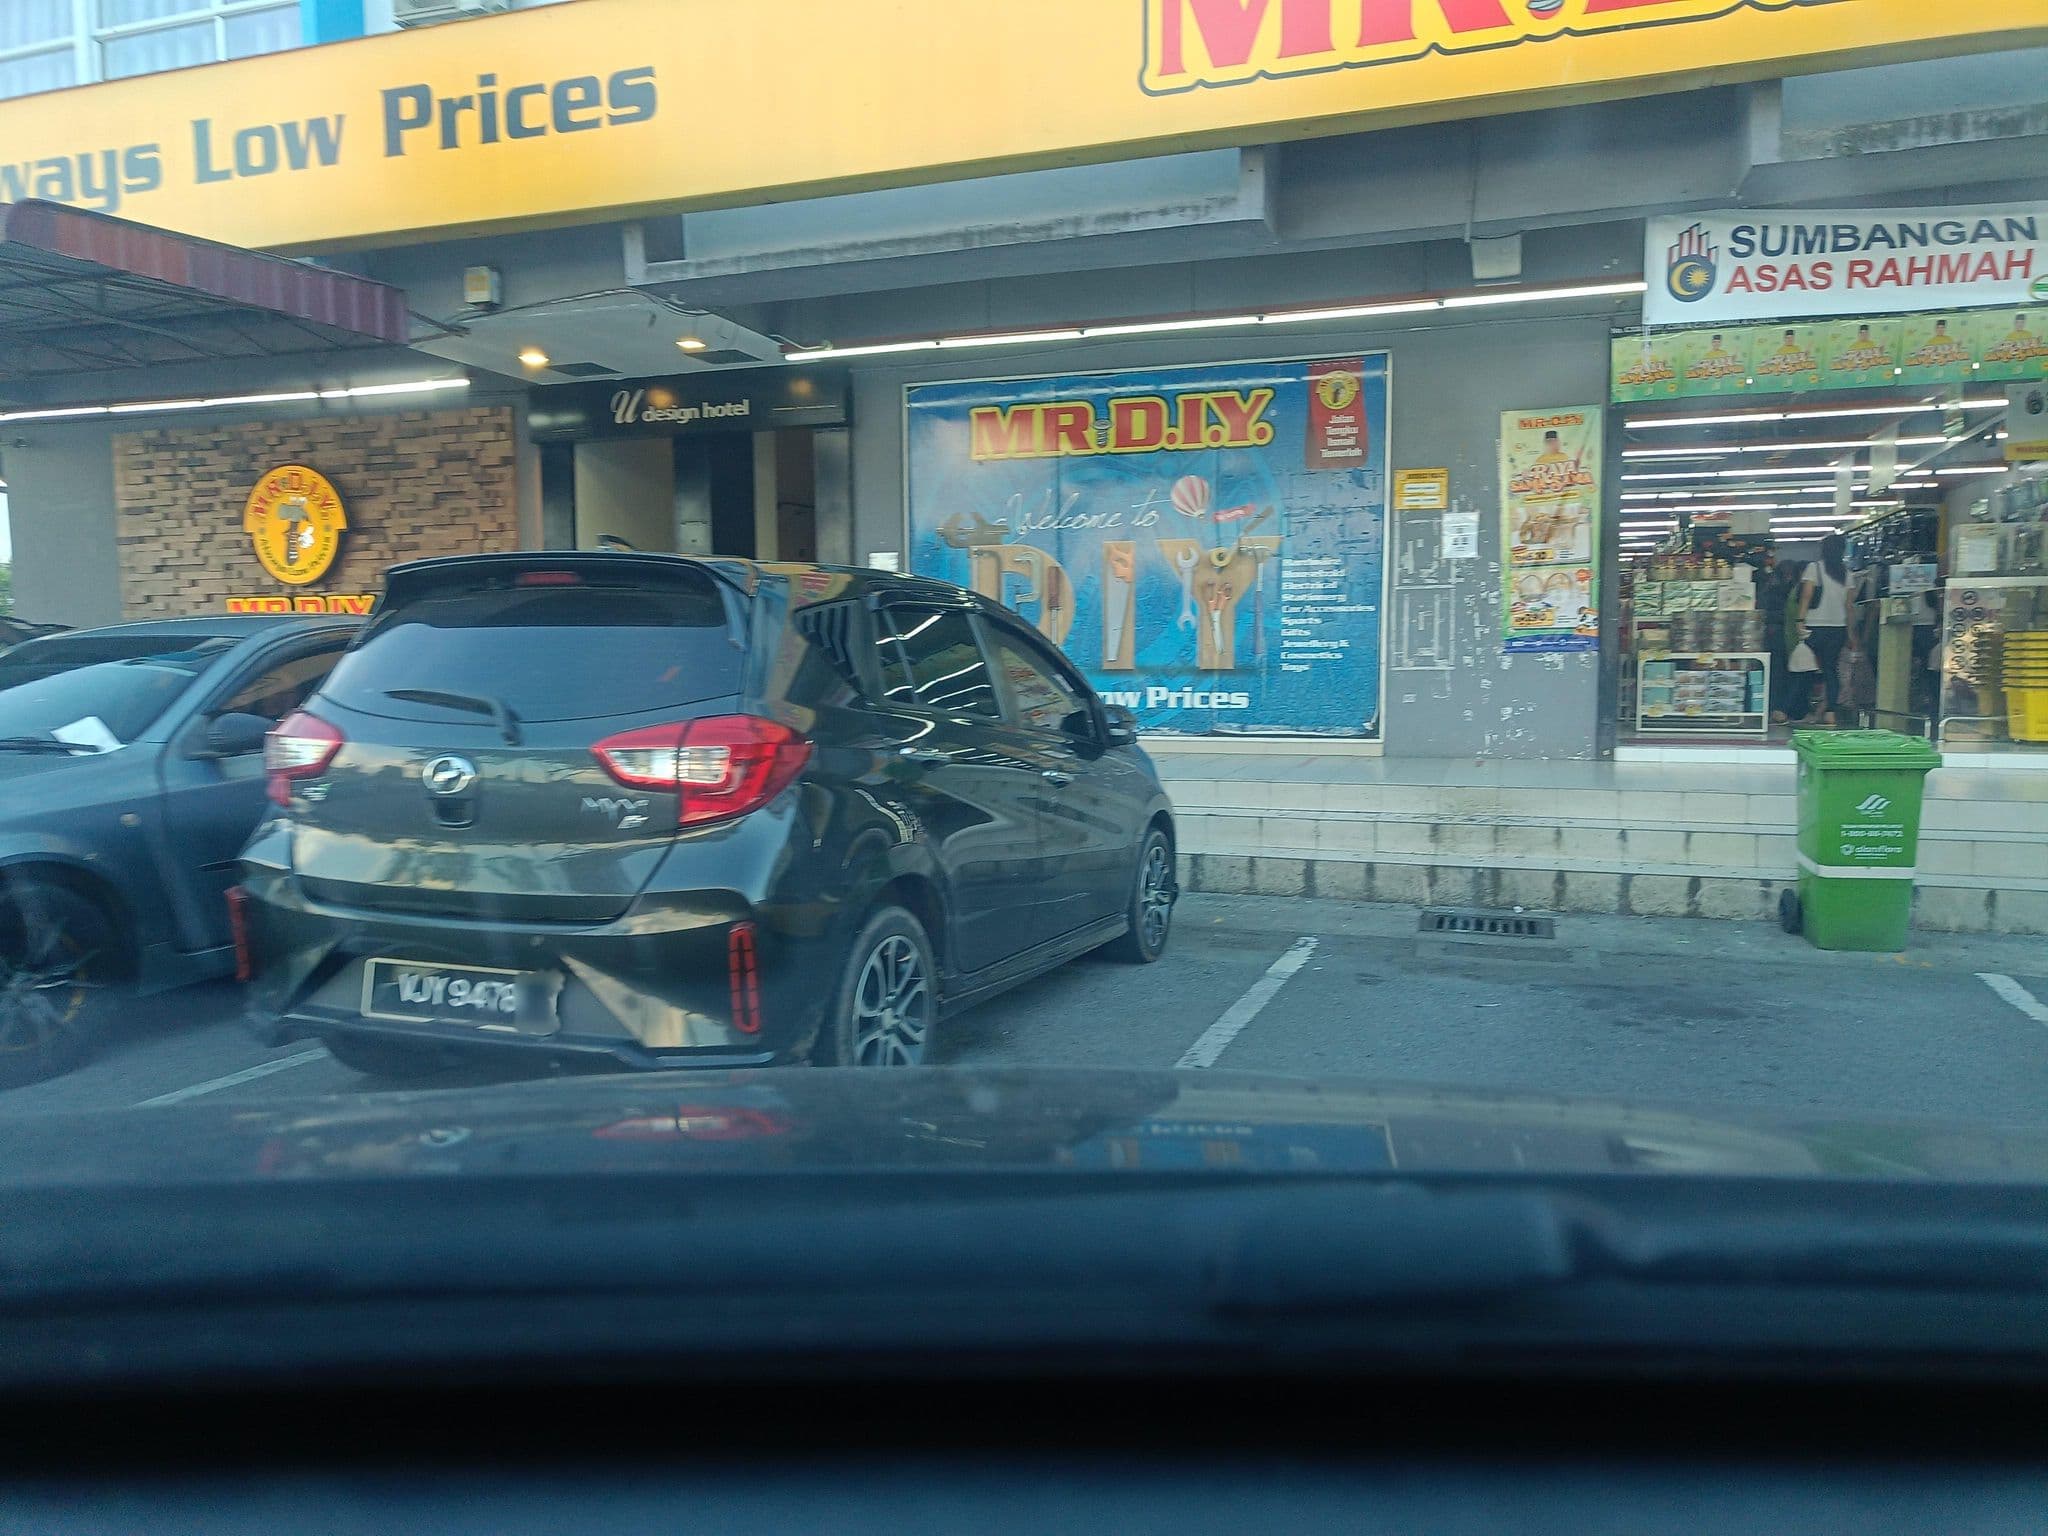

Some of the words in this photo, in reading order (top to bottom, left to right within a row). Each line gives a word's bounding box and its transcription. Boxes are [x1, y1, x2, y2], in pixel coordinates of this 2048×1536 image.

[192, 114, 346, 184] Low
[381, 66, 657, 157] Prices
[1728, 216, 2039, 258] SUMBANGAN
[1723, 260, 1834, 294] ASAS
[1846, 248, 2036, 289] RAHMAH
[641, 404, 701, 424] design
[702, 398, 750, 418] hotel
[993, 489, 1123, 544] Welcome
[1131, 488, 1173, 527] to
[1145, 686, 1250, 709] Prices
